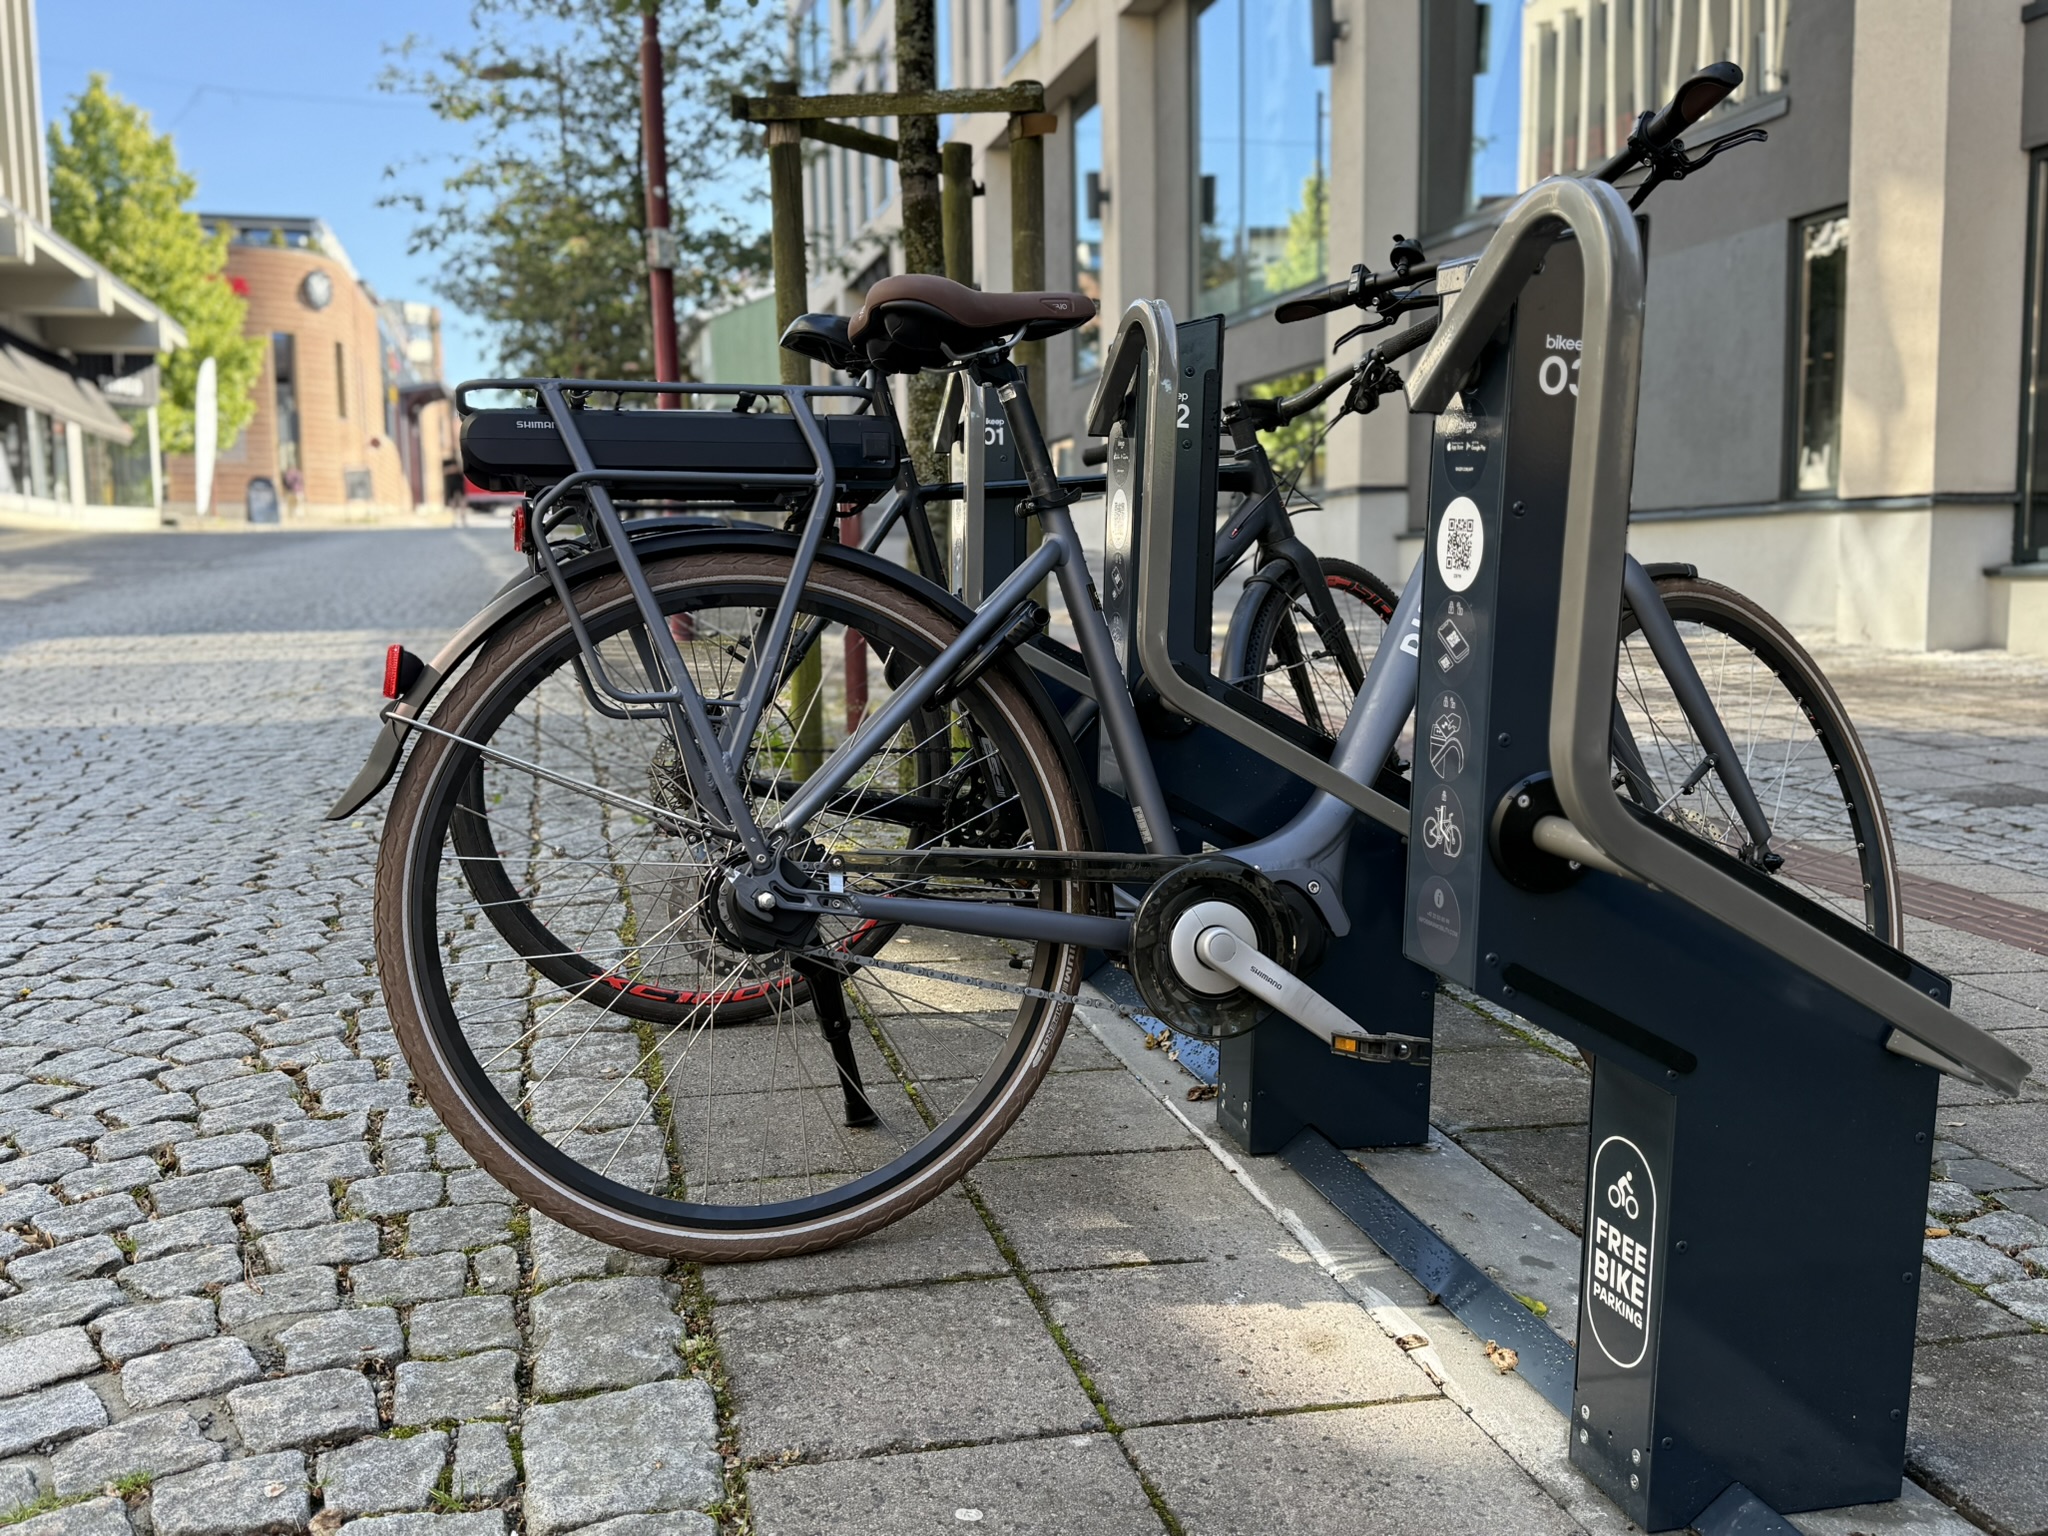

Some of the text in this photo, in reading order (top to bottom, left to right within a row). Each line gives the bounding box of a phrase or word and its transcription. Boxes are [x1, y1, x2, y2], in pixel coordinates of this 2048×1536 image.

[1545, 334, 1583, 351] bikee
[516, 420, 555, 429] SHIMA
[1176, 403, 1190, 429] 2
[984, 427, 1004, 446] 01
[1250, 965, 1283, 991] SHIMANO
[1596, 1216, 1648, 1275] FREE
[1594, 1247, 1645, 1310] BIKE
[1593, 1281, 1643, 1330] PARKING
